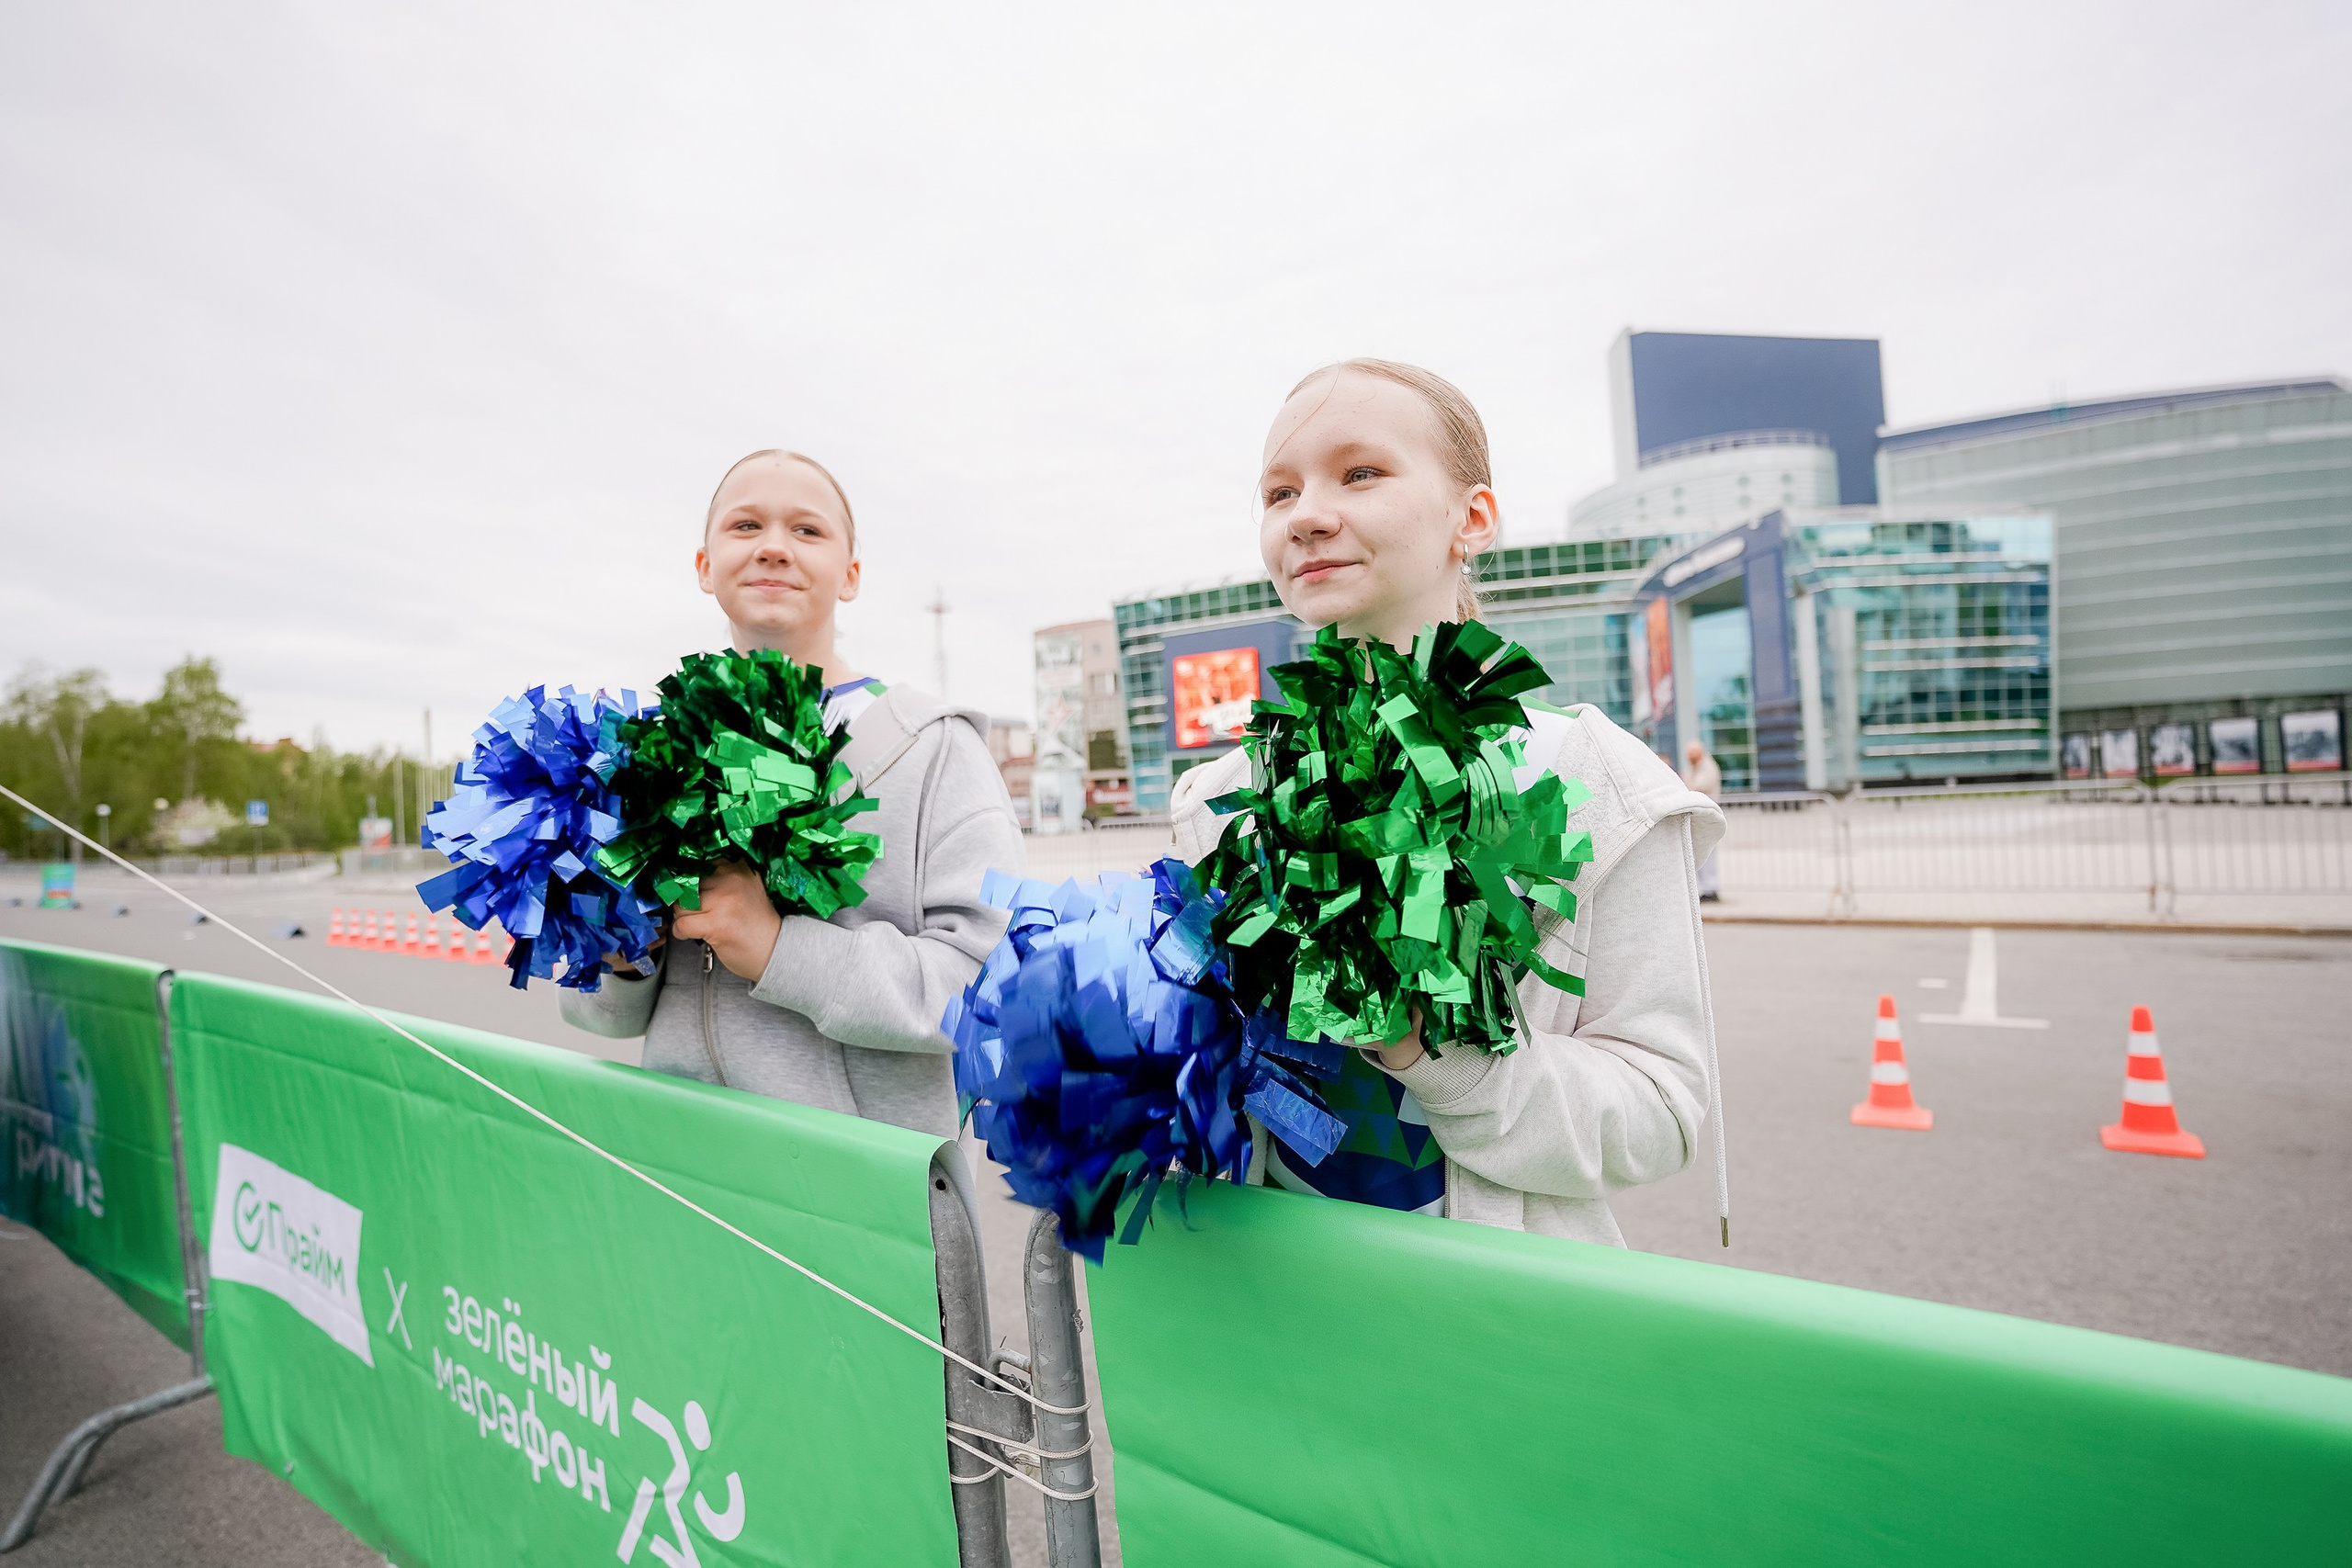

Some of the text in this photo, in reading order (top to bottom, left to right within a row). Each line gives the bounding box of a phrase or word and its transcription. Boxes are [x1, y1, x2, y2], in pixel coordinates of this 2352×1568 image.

[268, 1201, 346, 1297] Прайм
[433, 1346, 612, 1513] марафон
[442, 1285, 620, 1438] зелёный
